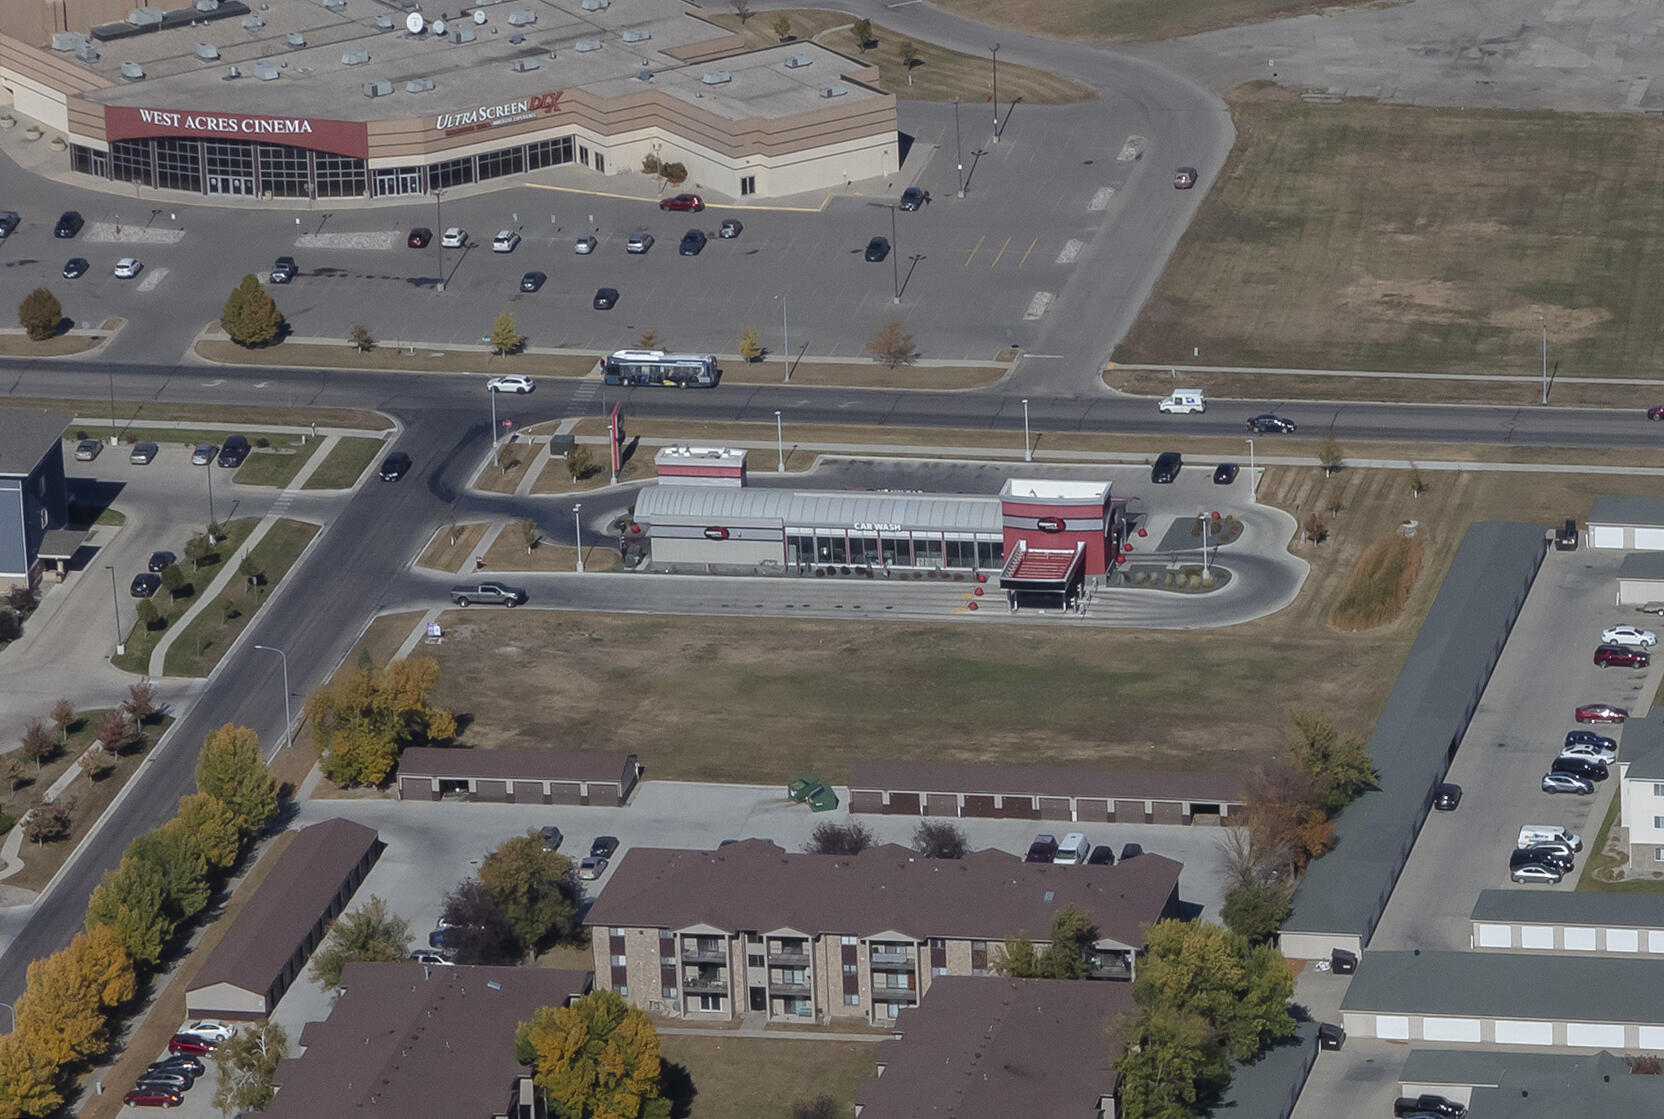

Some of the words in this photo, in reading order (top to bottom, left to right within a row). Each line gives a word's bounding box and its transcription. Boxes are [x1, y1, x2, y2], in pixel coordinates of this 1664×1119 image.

[139, 108, 181, 128] WEST
[185, 115, 238, 133] ACRES
[241, 119, 312, 133] CINEMA
[854, 522, 873, 530] CAR
[874, 523, 901, 531] WASH
